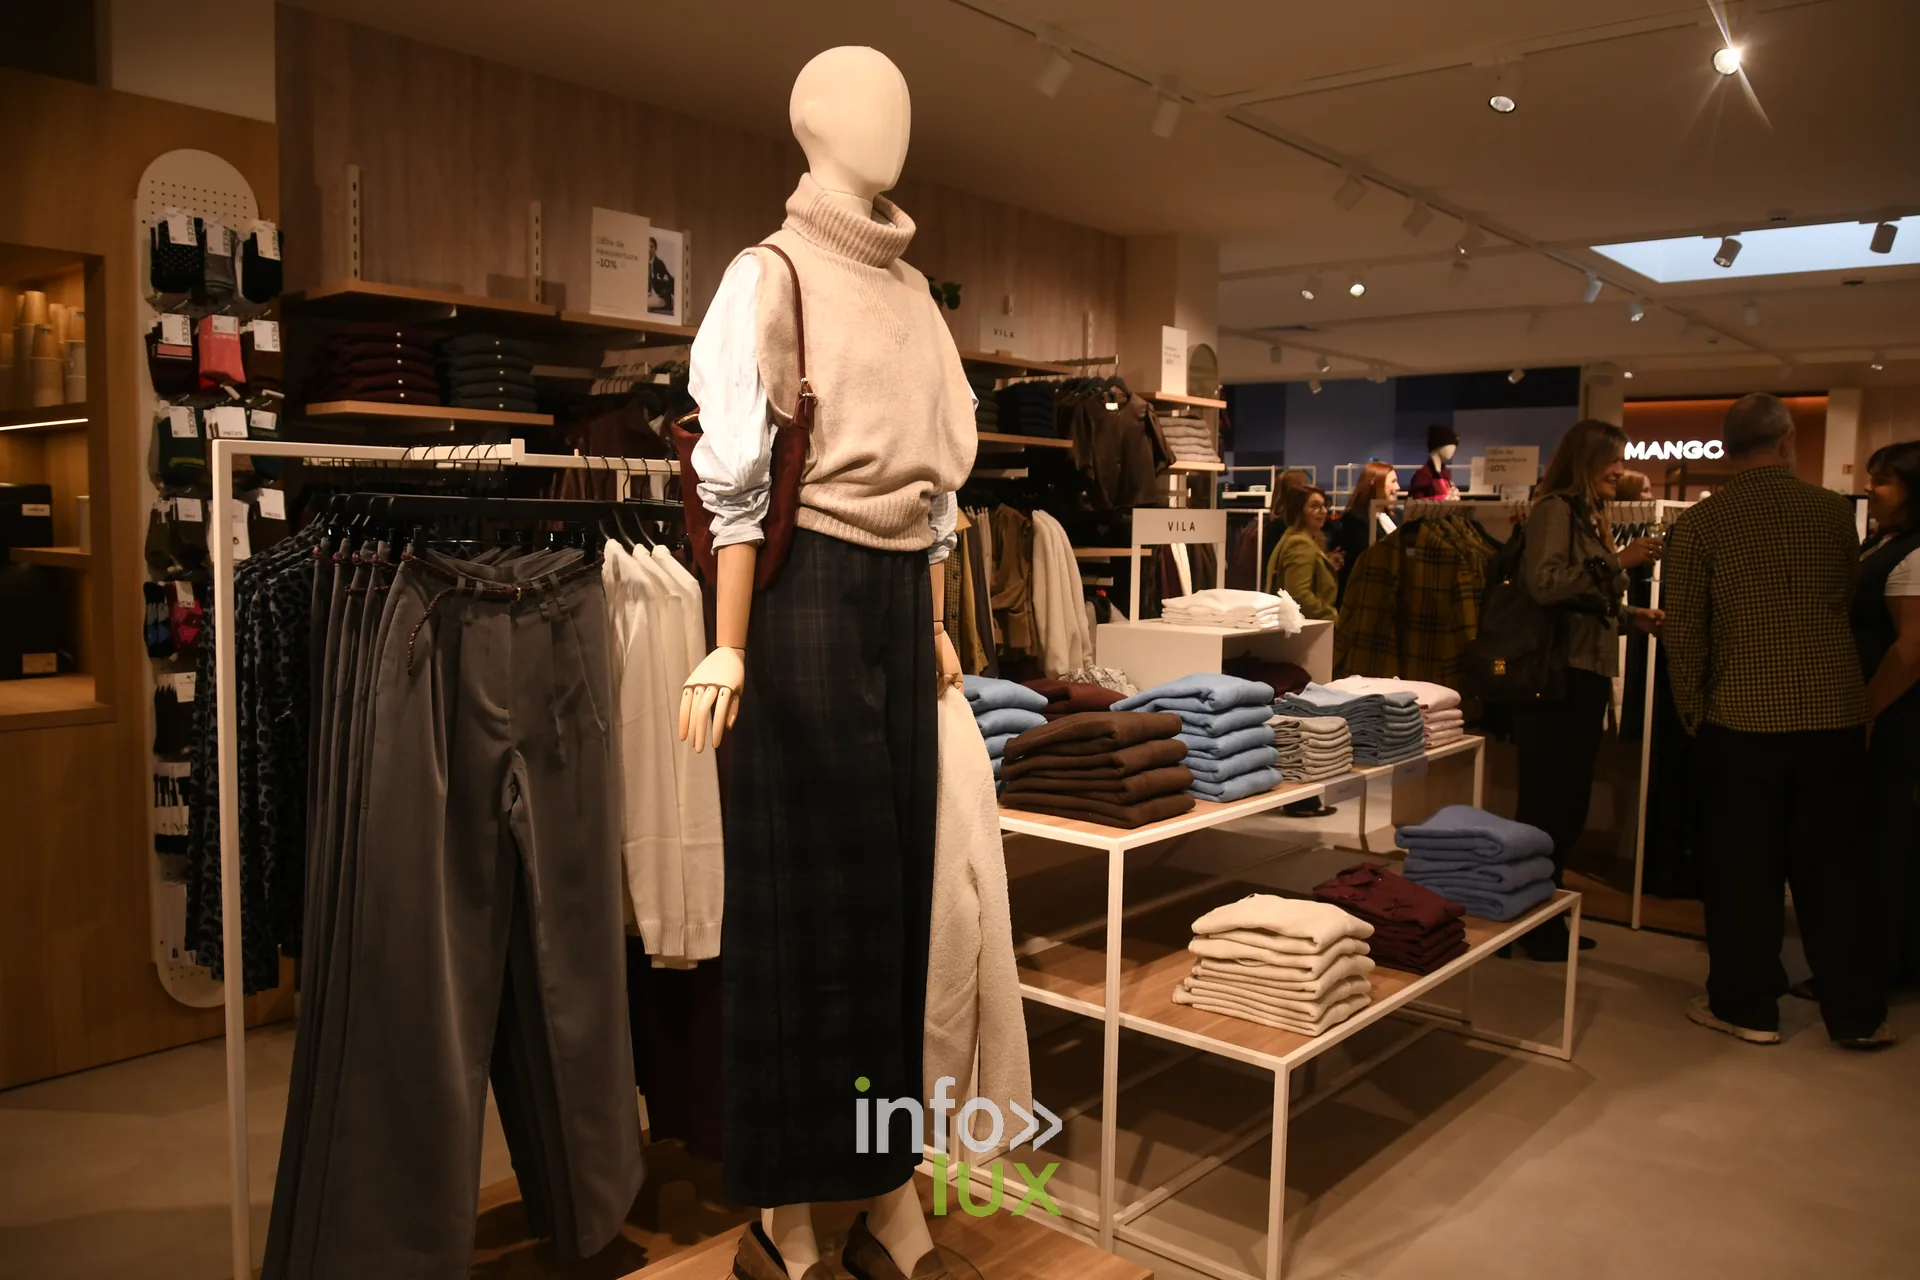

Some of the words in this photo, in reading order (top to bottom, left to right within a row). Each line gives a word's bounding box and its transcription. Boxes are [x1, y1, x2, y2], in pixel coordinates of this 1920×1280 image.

[186, 215, 194, 242] PIECES
[596, 258, 617, 270] -10%
[181, 315, 190, 343] PIECES
[271, 322, 279, 349] PIECES
[993, 327, 1015, 339] VILA
[187, 406, 196, 435] PIECES
[1624, 439, 1725, 460] MANGO
[1167, 521, 1196, 531] VILA
